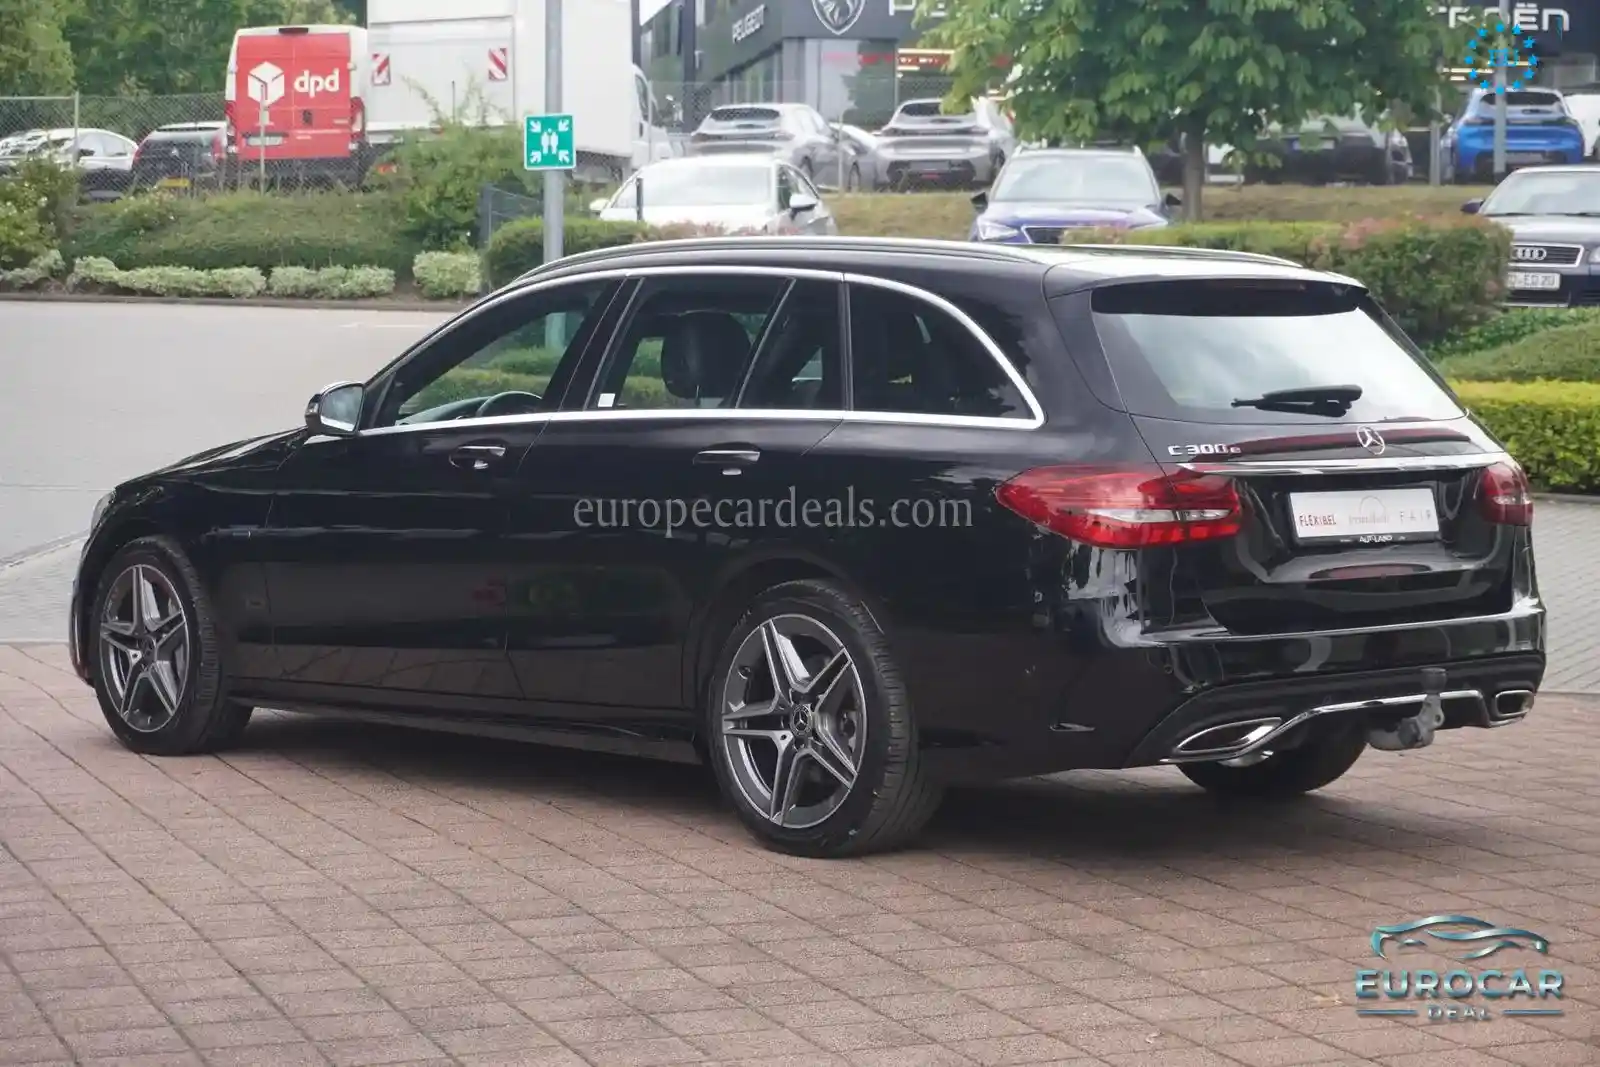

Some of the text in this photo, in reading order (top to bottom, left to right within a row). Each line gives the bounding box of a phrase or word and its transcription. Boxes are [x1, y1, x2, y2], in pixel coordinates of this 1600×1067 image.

[732, 4, 764, 43] PEUGEOT
[294, 67, 340, 98] dpd
[1167, 445, 1183, 456] C
[1298, 514, 1337, 527] FLEXIBEL
